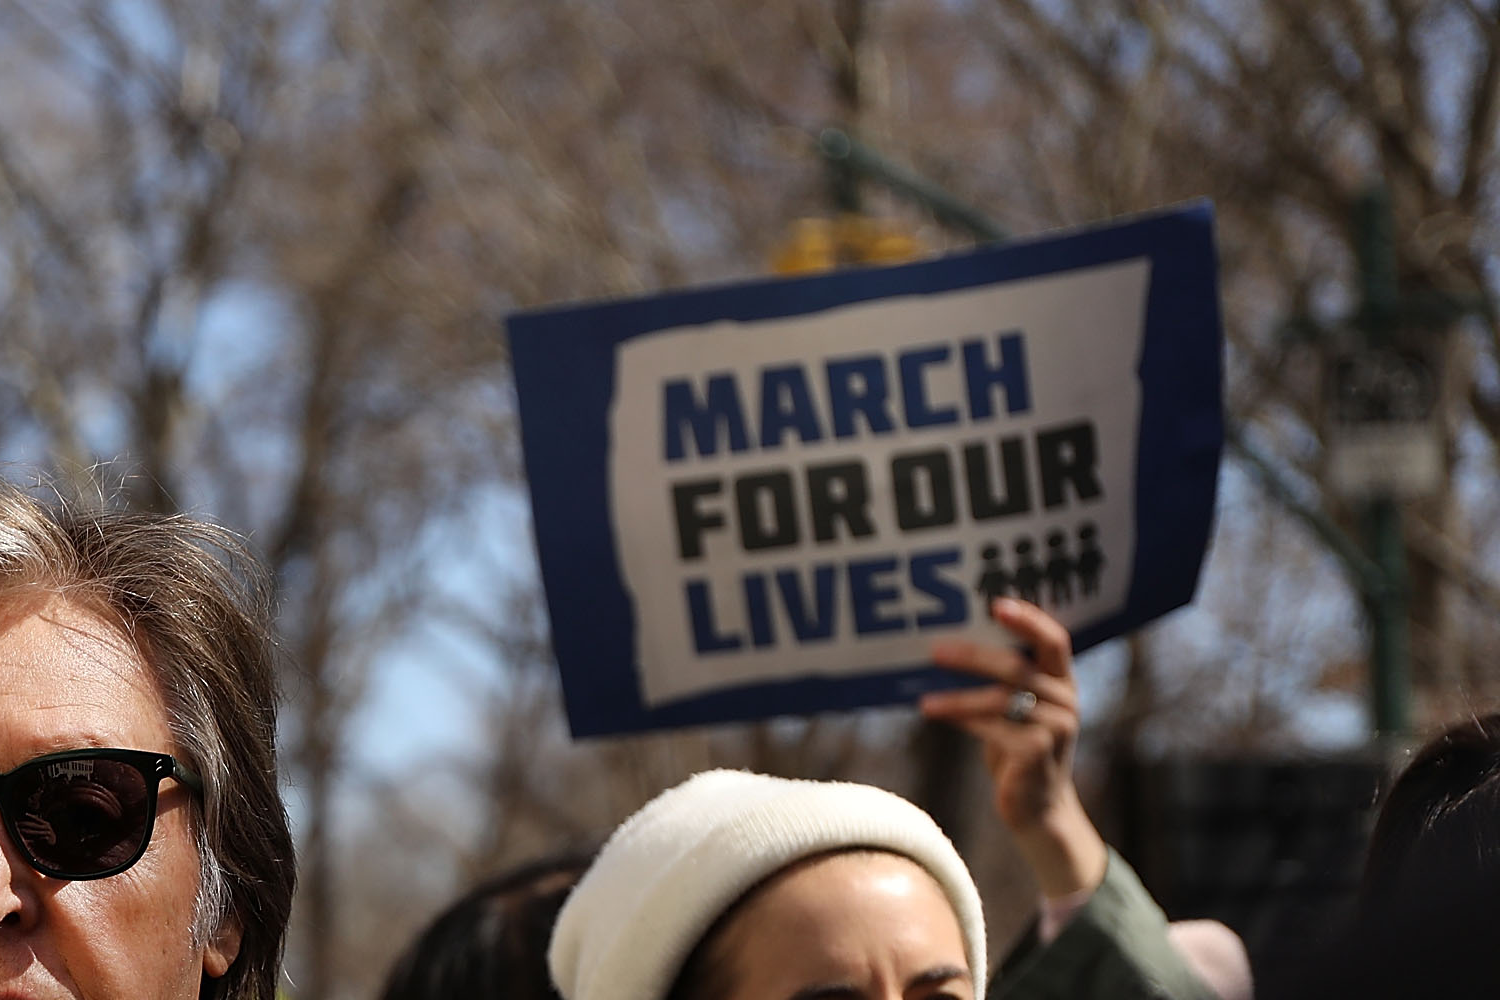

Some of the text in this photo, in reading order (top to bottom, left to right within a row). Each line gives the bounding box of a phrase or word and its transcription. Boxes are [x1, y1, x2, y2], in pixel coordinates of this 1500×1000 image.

[662, 332, 1032, 463] MARCH
[670, 418, 1103, 561] FOR OUR
[685, 546, 972, 656] LIVES
